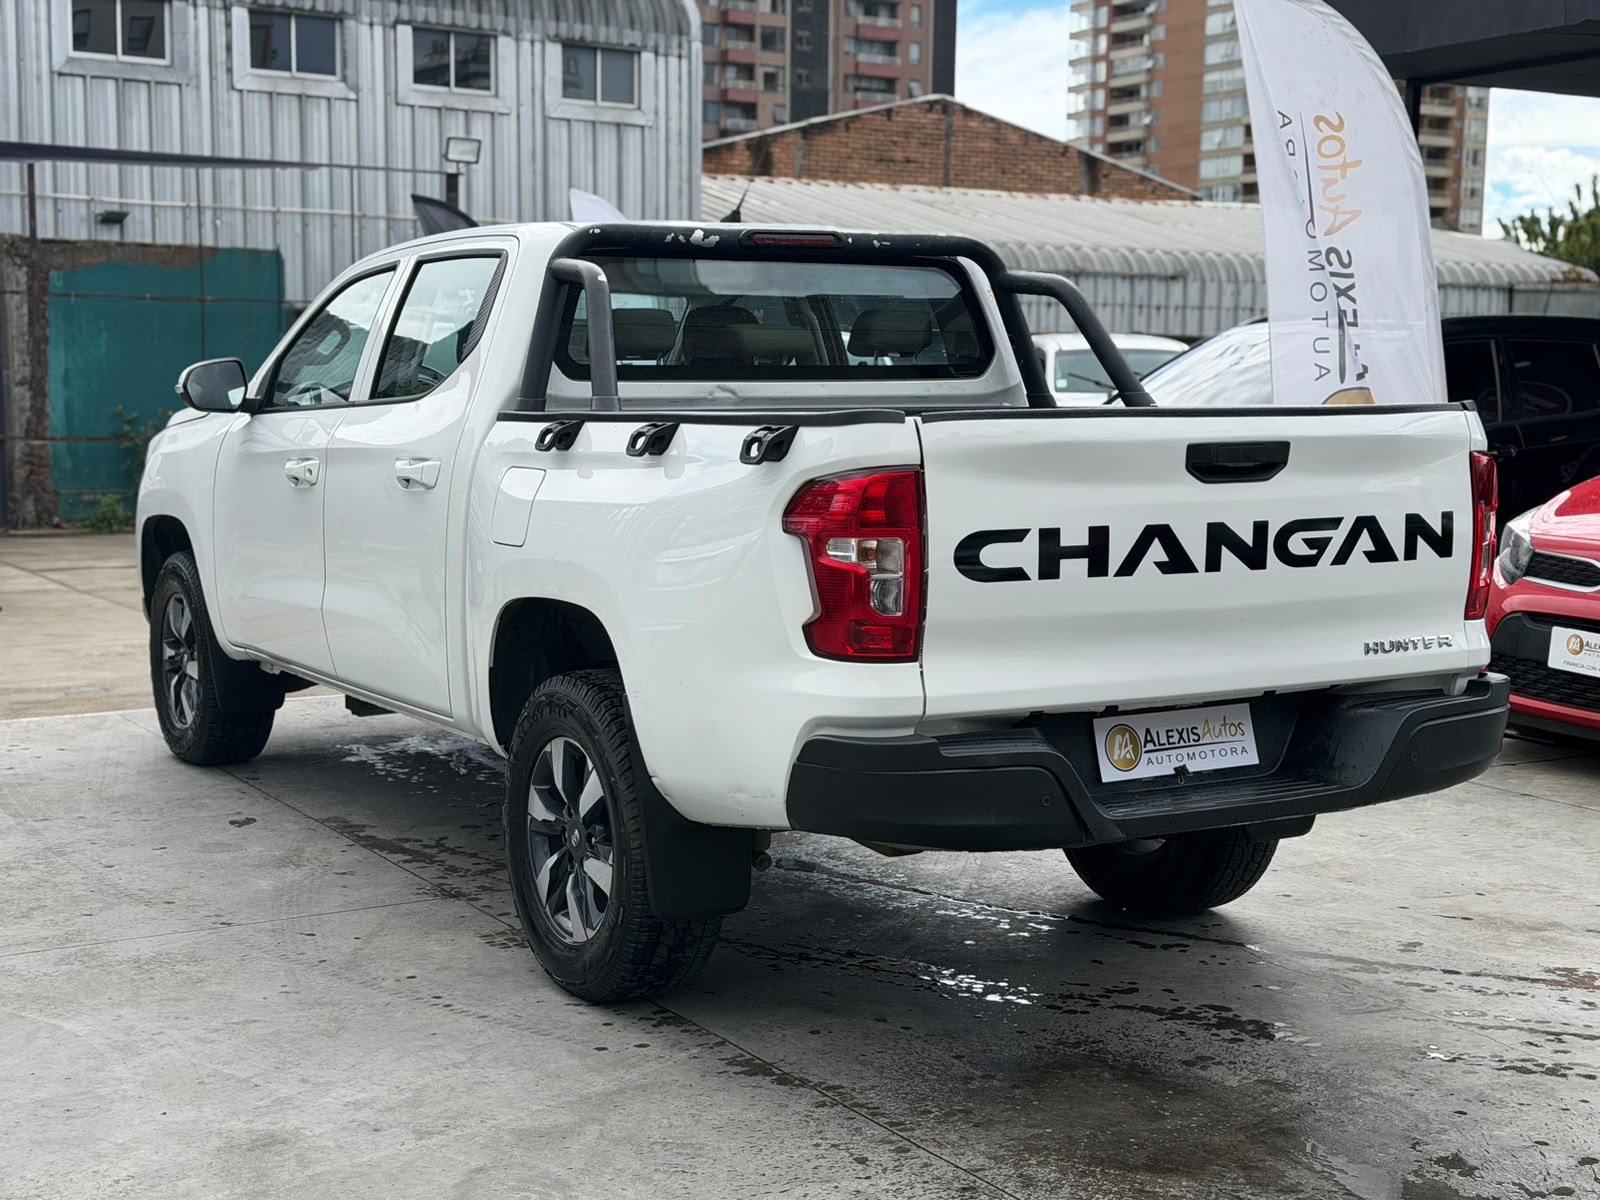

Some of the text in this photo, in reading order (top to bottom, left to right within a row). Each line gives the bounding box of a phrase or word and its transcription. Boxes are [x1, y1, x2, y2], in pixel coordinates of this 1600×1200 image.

[953, 511, 1453, 583] CHANGAN
[1364, 634, 1453, 656] HUNTER
[1146, 746, 1249, 766] AUTOMOTORA
